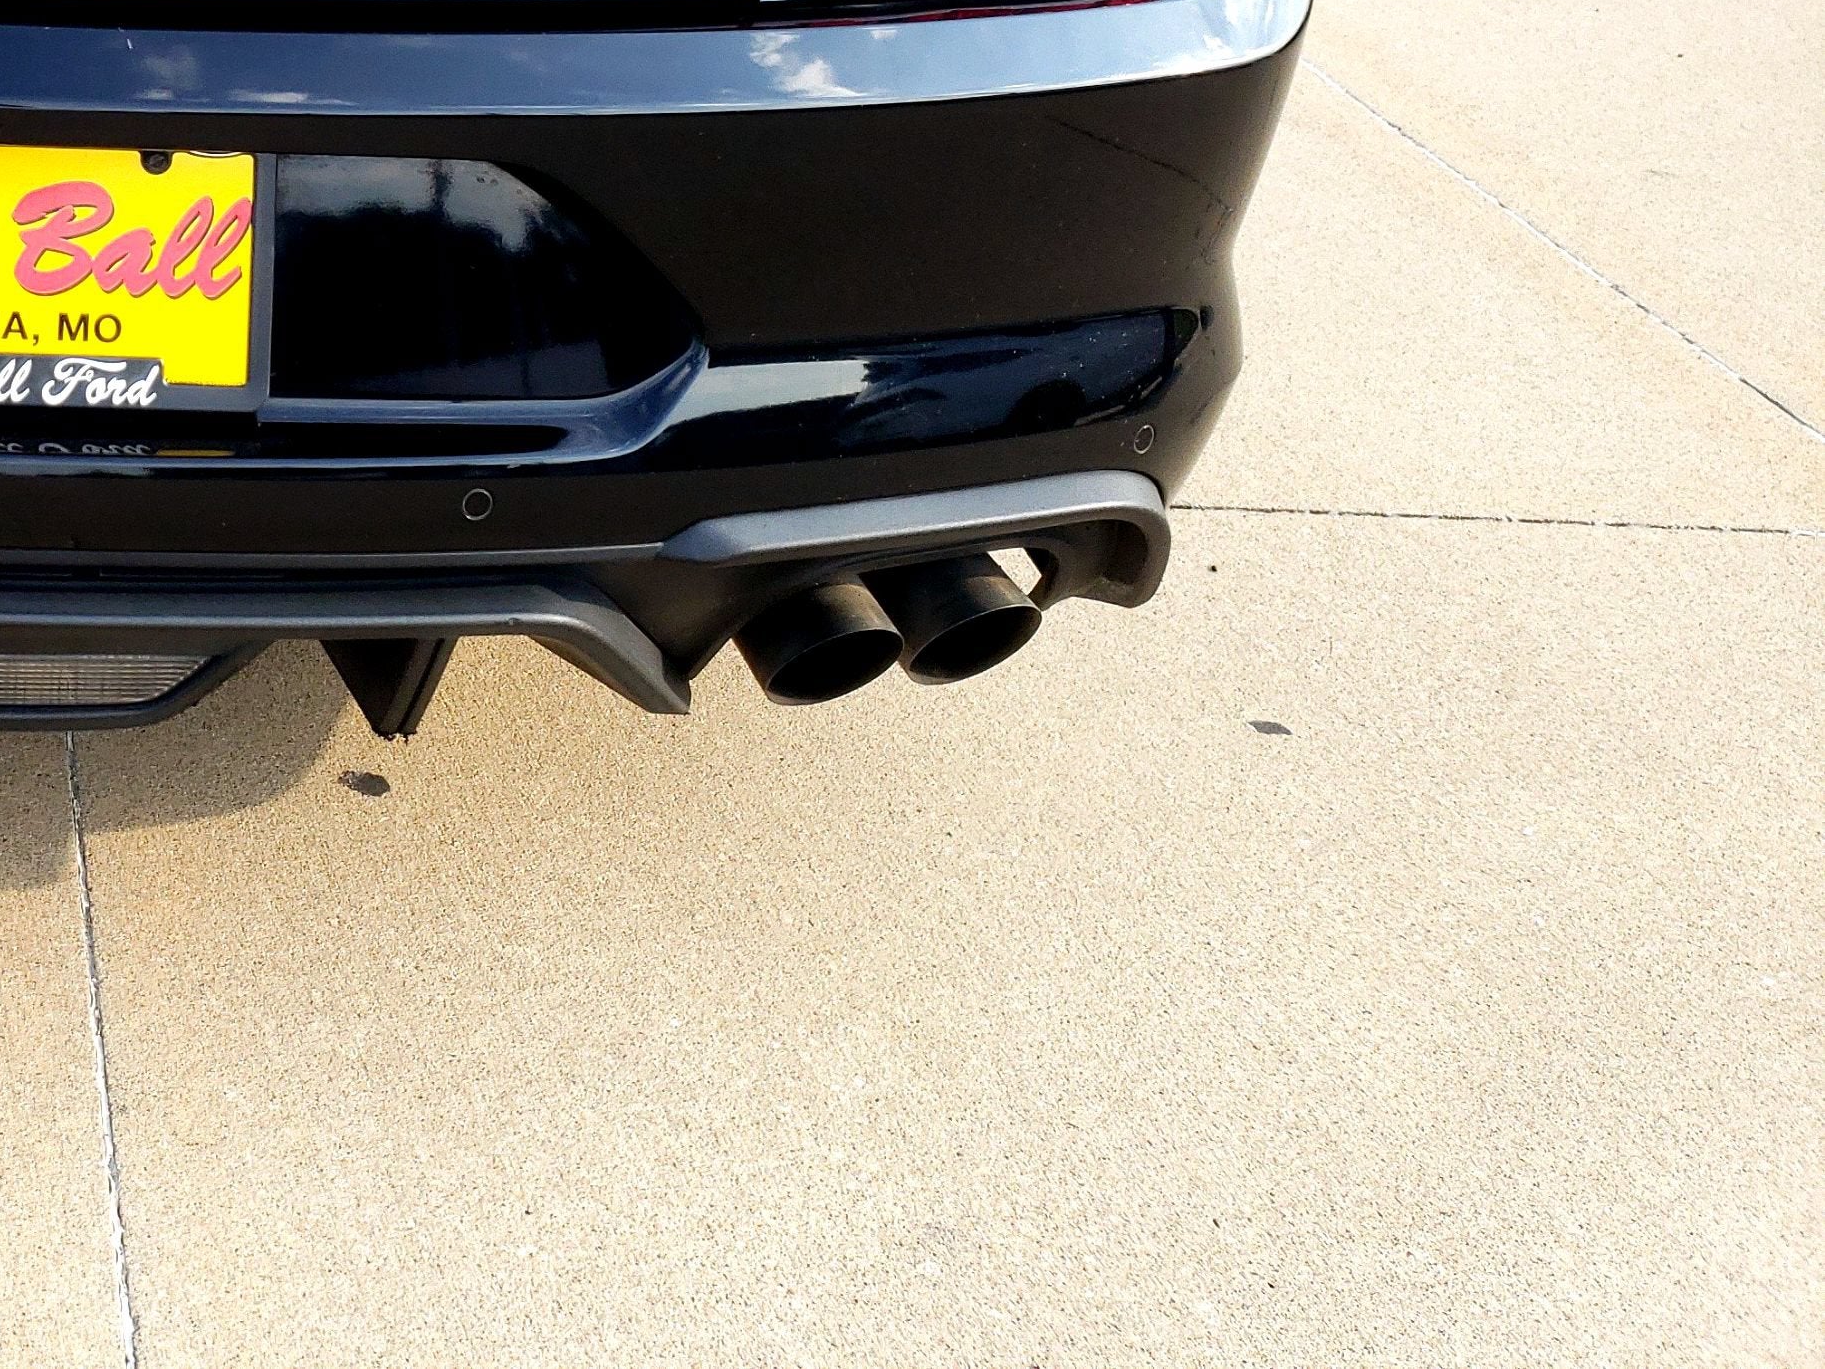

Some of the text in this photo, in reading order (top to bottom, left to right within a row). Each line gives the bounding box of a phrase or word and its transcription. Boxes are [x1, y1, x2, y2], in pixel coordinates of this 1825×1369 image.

[12, 180, 253, 299] Ball
[57, 312, 123, 344] MO
[41, 357, 160, 407] Ford
